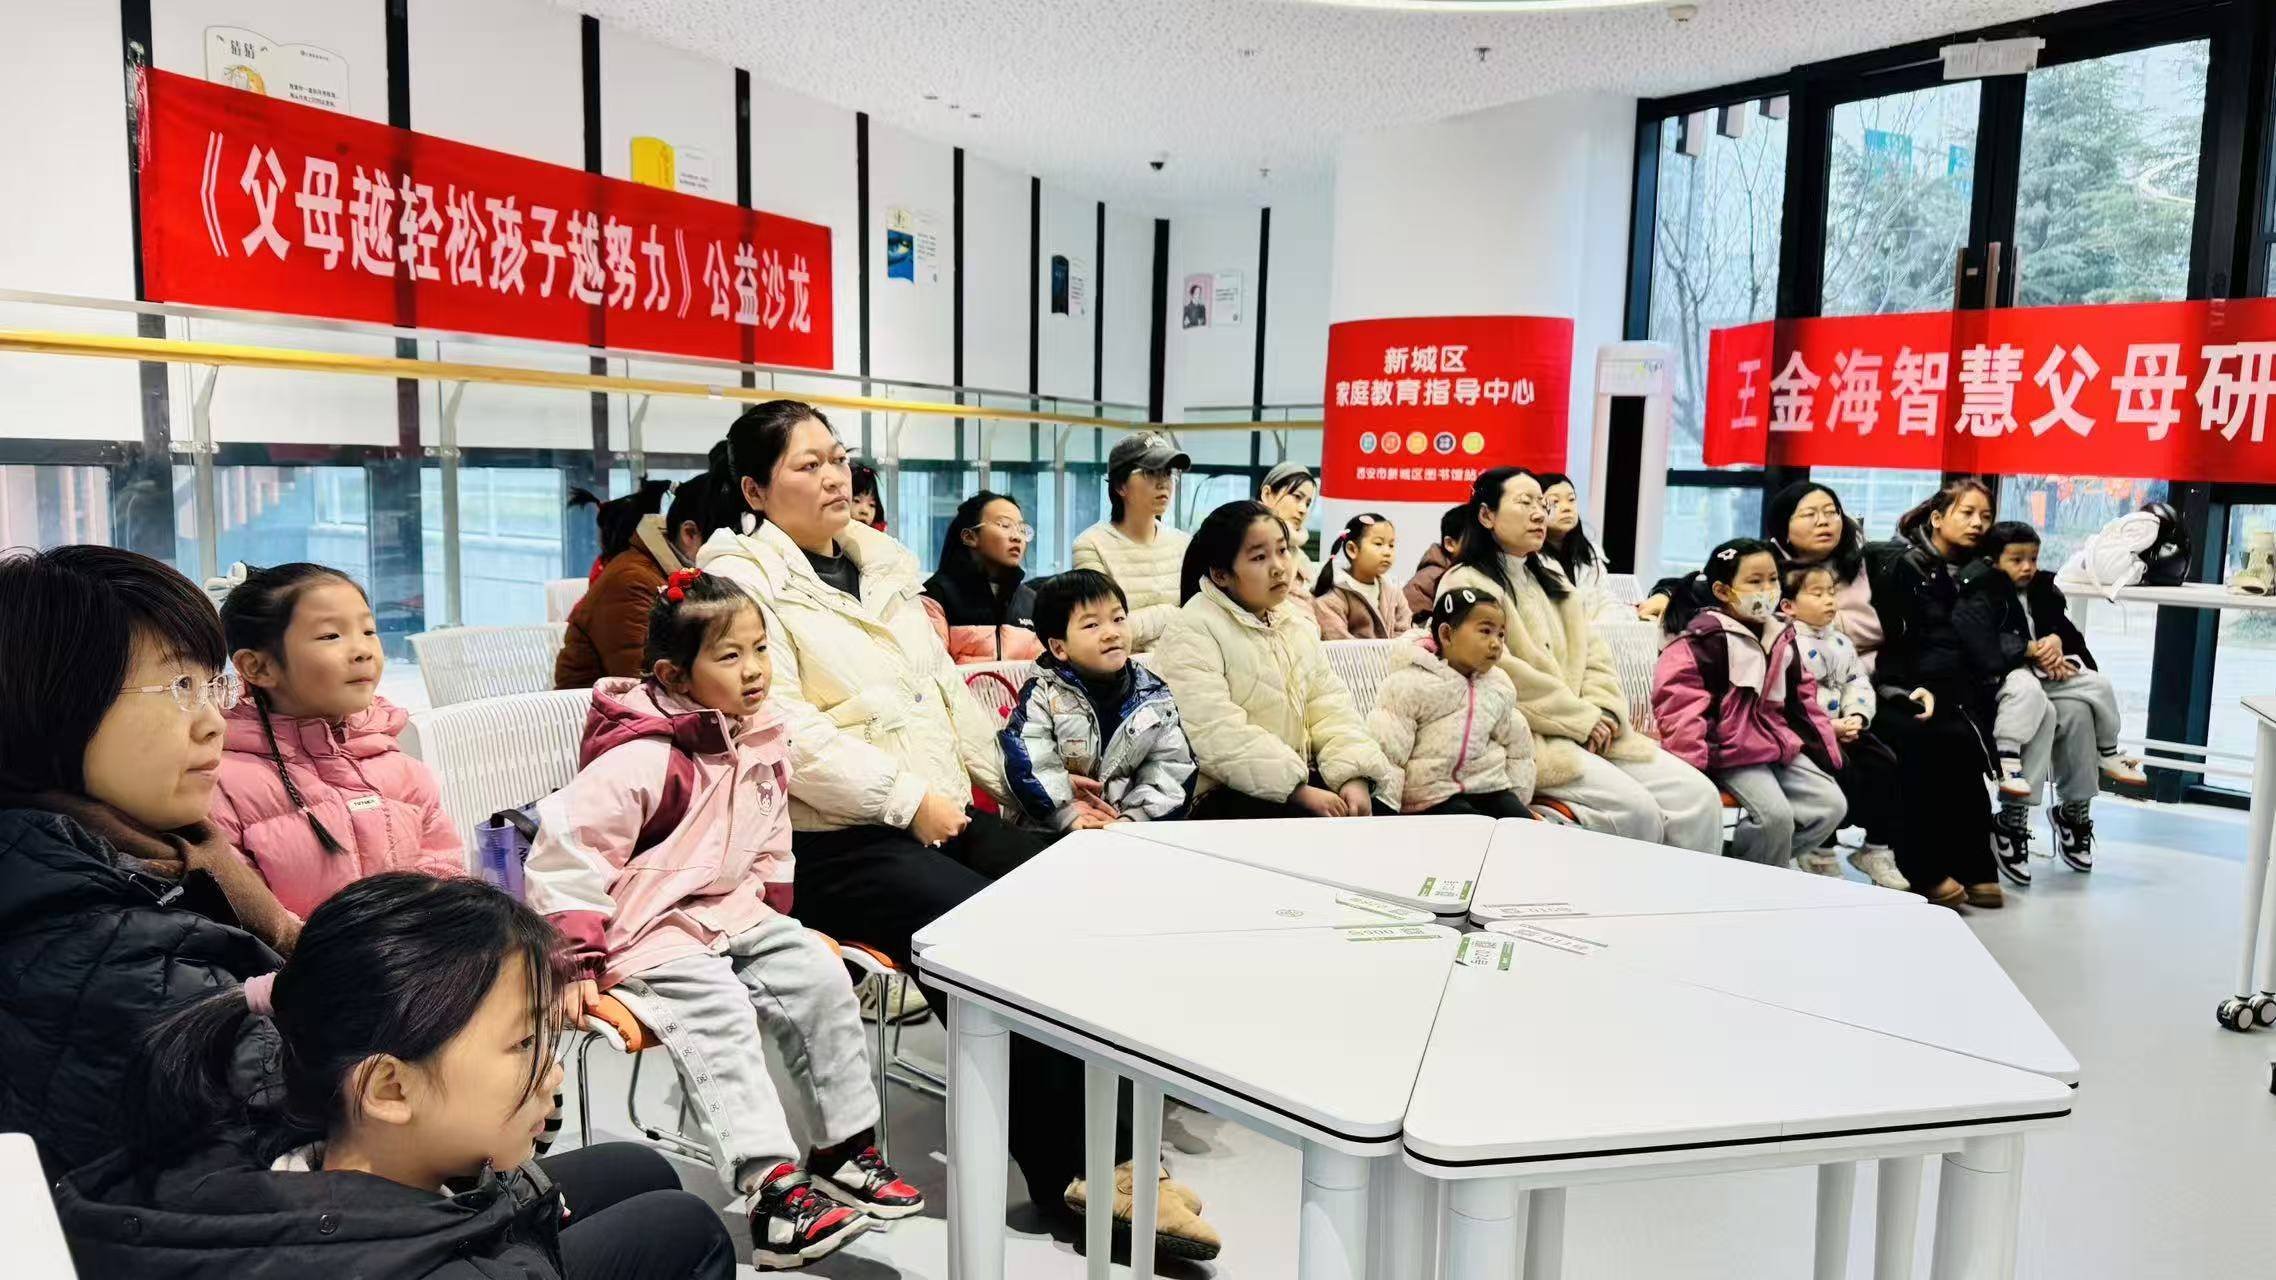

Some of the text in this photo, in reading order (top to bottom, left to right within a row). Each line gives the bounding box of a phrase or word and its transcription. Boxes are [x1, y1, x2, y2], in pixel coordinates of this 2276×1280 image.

[1384, 345, 1468, 374] 新城区
[1335, 377, 1535, 407] 家庭教育指导中心
[1731, 341, 2276, 442] 王金海智慧父母研
[1356, 466, 1486, 482] 西安市新城区图书馆站
